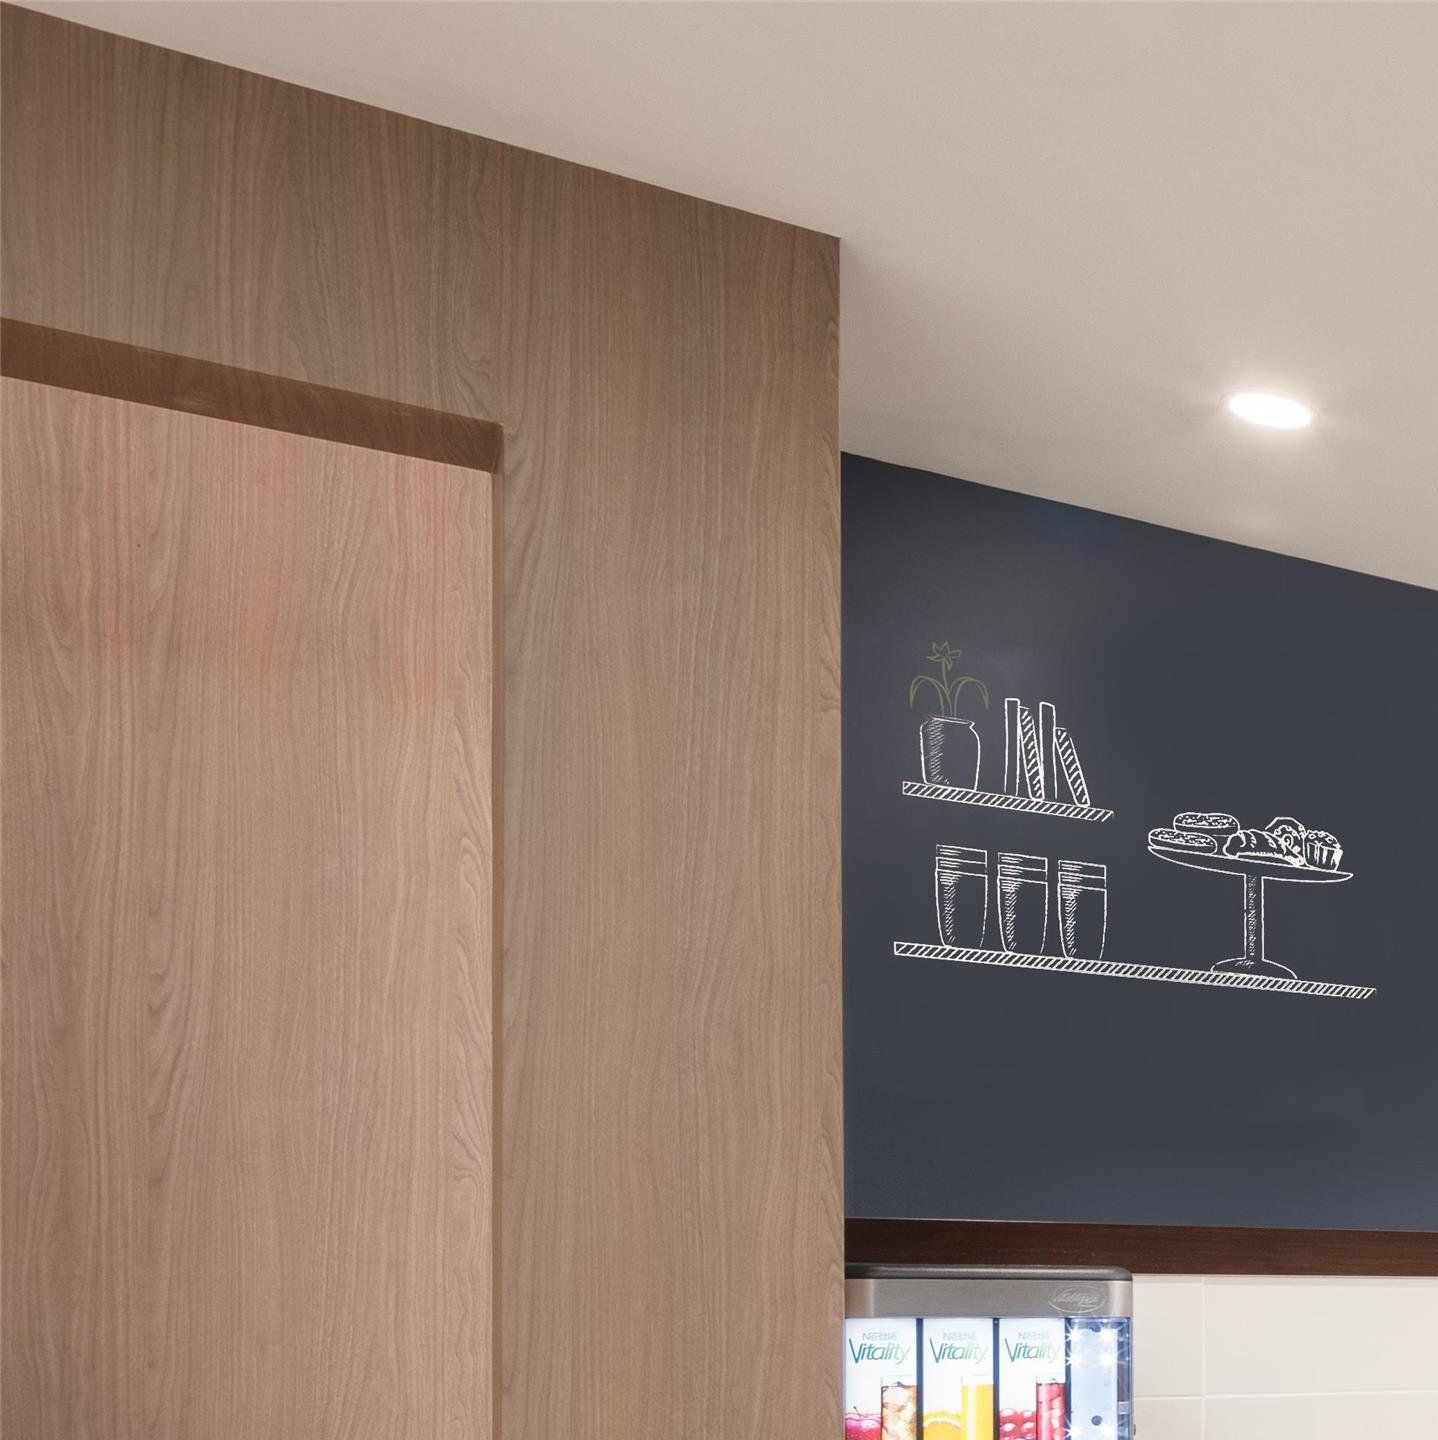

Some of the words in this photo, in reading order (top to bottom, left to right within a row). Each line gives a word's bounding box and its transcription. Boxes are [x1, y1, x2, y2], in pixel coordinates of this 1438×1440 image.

[849, 1338, 911, 1365] Vitality
[929, 1337, 989, 1364] Vitality
[1004, 1337, 1060, 1363] Vitality
